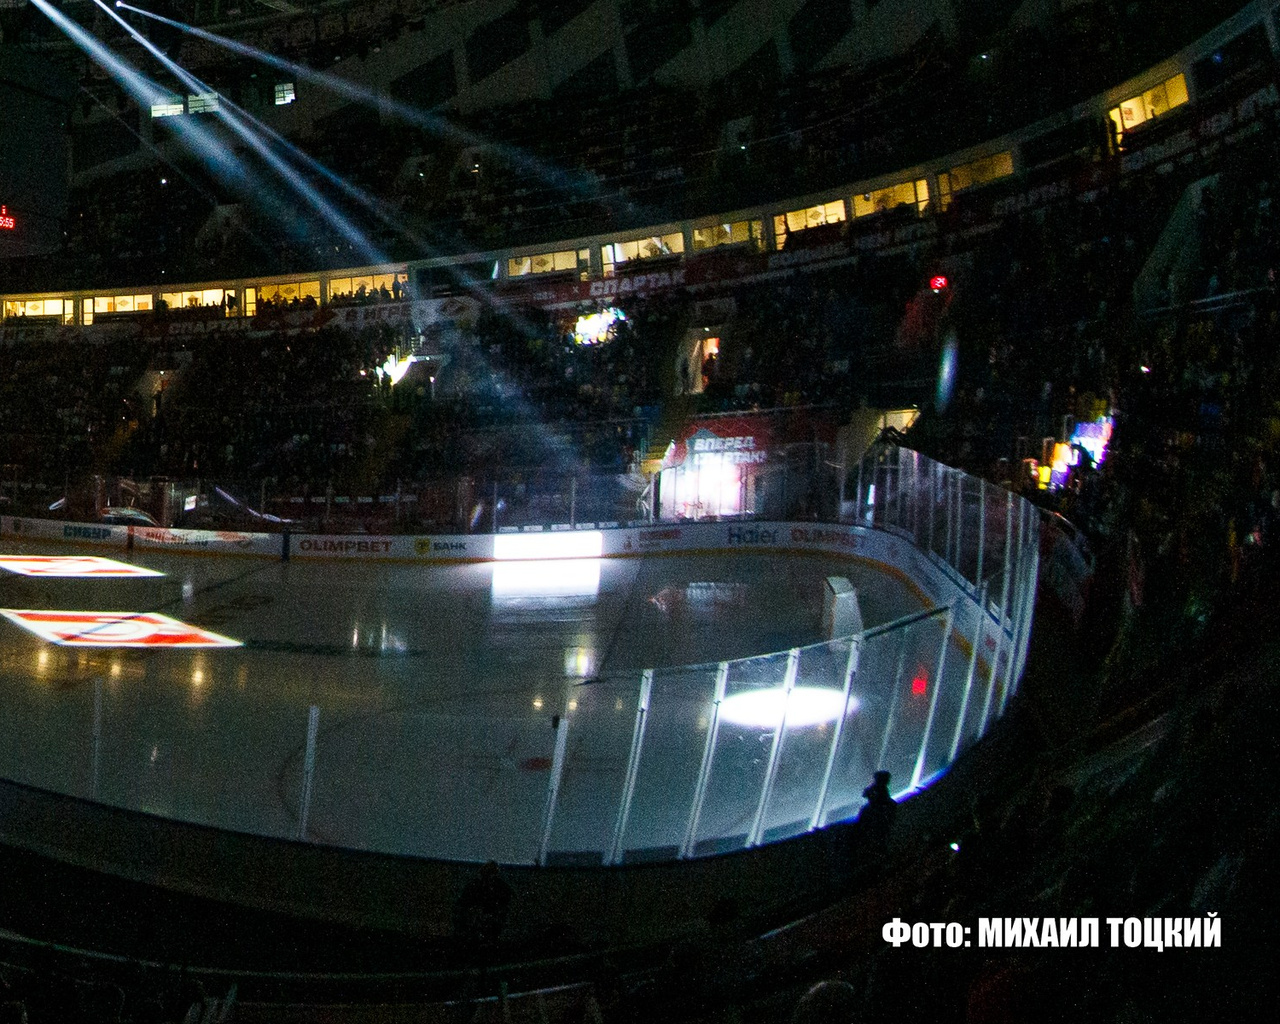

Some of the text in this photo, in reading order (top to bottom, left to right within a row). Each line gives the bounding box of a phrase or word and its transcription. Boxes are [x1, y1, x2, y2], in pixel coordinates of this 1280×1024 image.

[589, 269, 687, 296] СПАРТАК
[168, 317, 254, 335] СПАРТАК
[64, 525, 111, 539] СИБУР
[728, 524, 779, 544] Haier
[299, 539, 393, 552] OLIMPBET
[433, 541, 467, 552] БАНК
